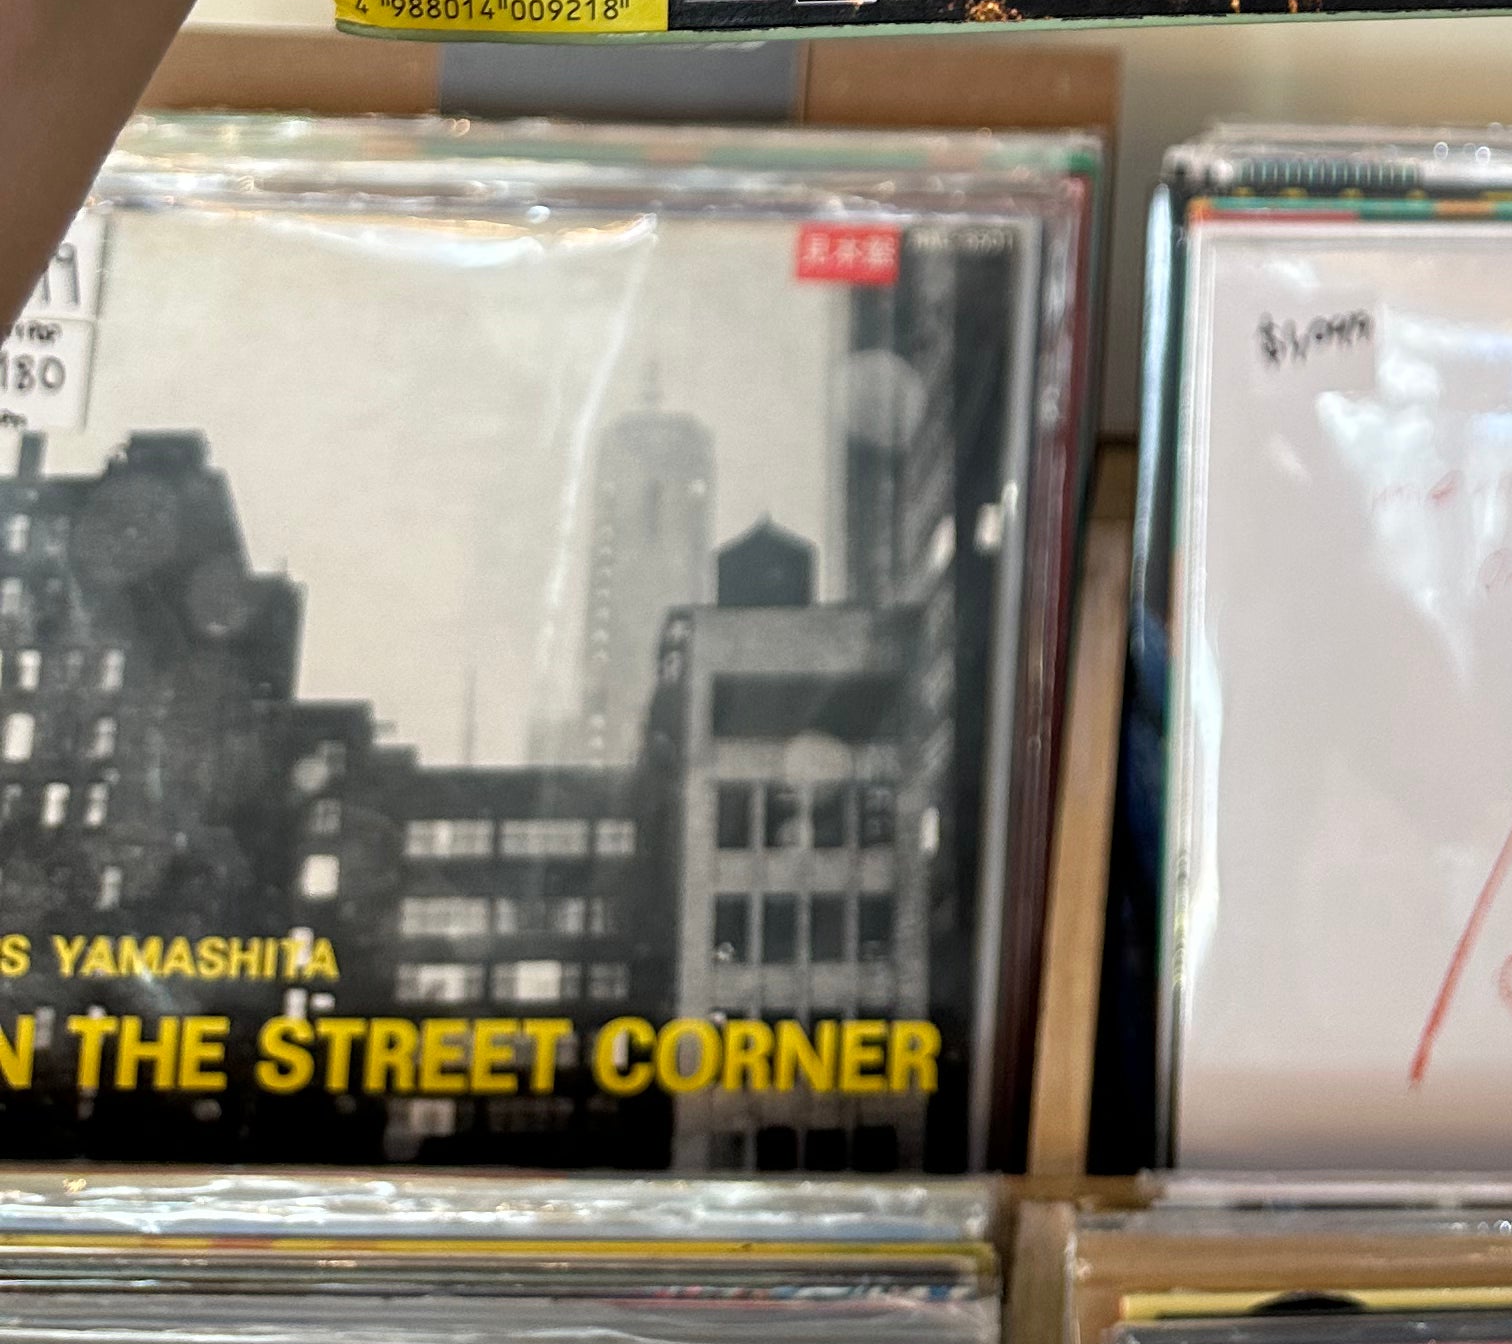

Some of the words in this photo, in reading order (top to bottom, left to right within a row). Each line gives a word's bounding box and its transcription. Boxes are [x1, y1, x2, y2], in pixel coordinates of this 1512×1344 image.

[52, 934, 341, 981] YAMASHITA
[67, 1014, 230, 1092] THE
[255, 1015, 574, 1095] STREET
[593, 1016, 943, 1096] CORNER
